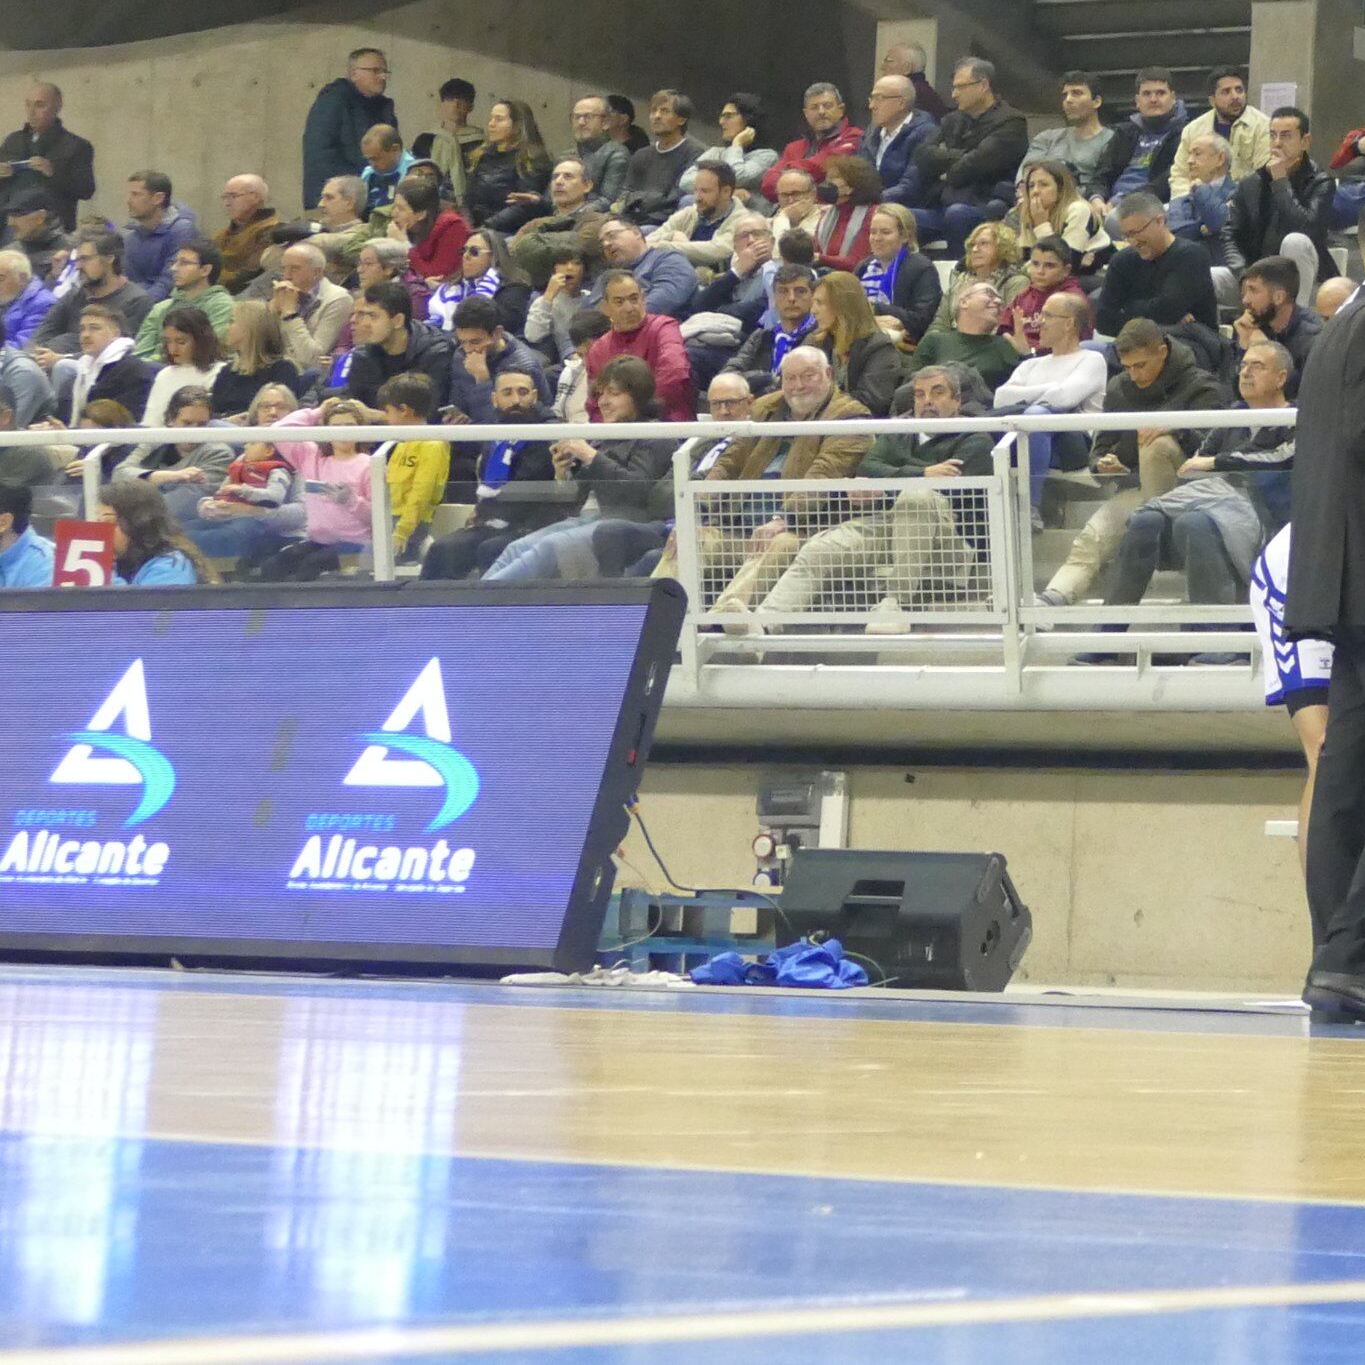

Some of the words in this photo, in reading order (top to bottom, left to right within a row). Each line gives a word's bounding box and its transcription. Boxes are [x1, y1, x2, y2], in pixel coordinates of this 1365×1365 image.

[61, 539, 105, 587] 5
[13, 809, 98, 827] DEPORTES
[305, 813, 396, 831] DEPORTES
[0, 830, 171, 876] Alicante
[289, 834, 476, 883] Alicante
